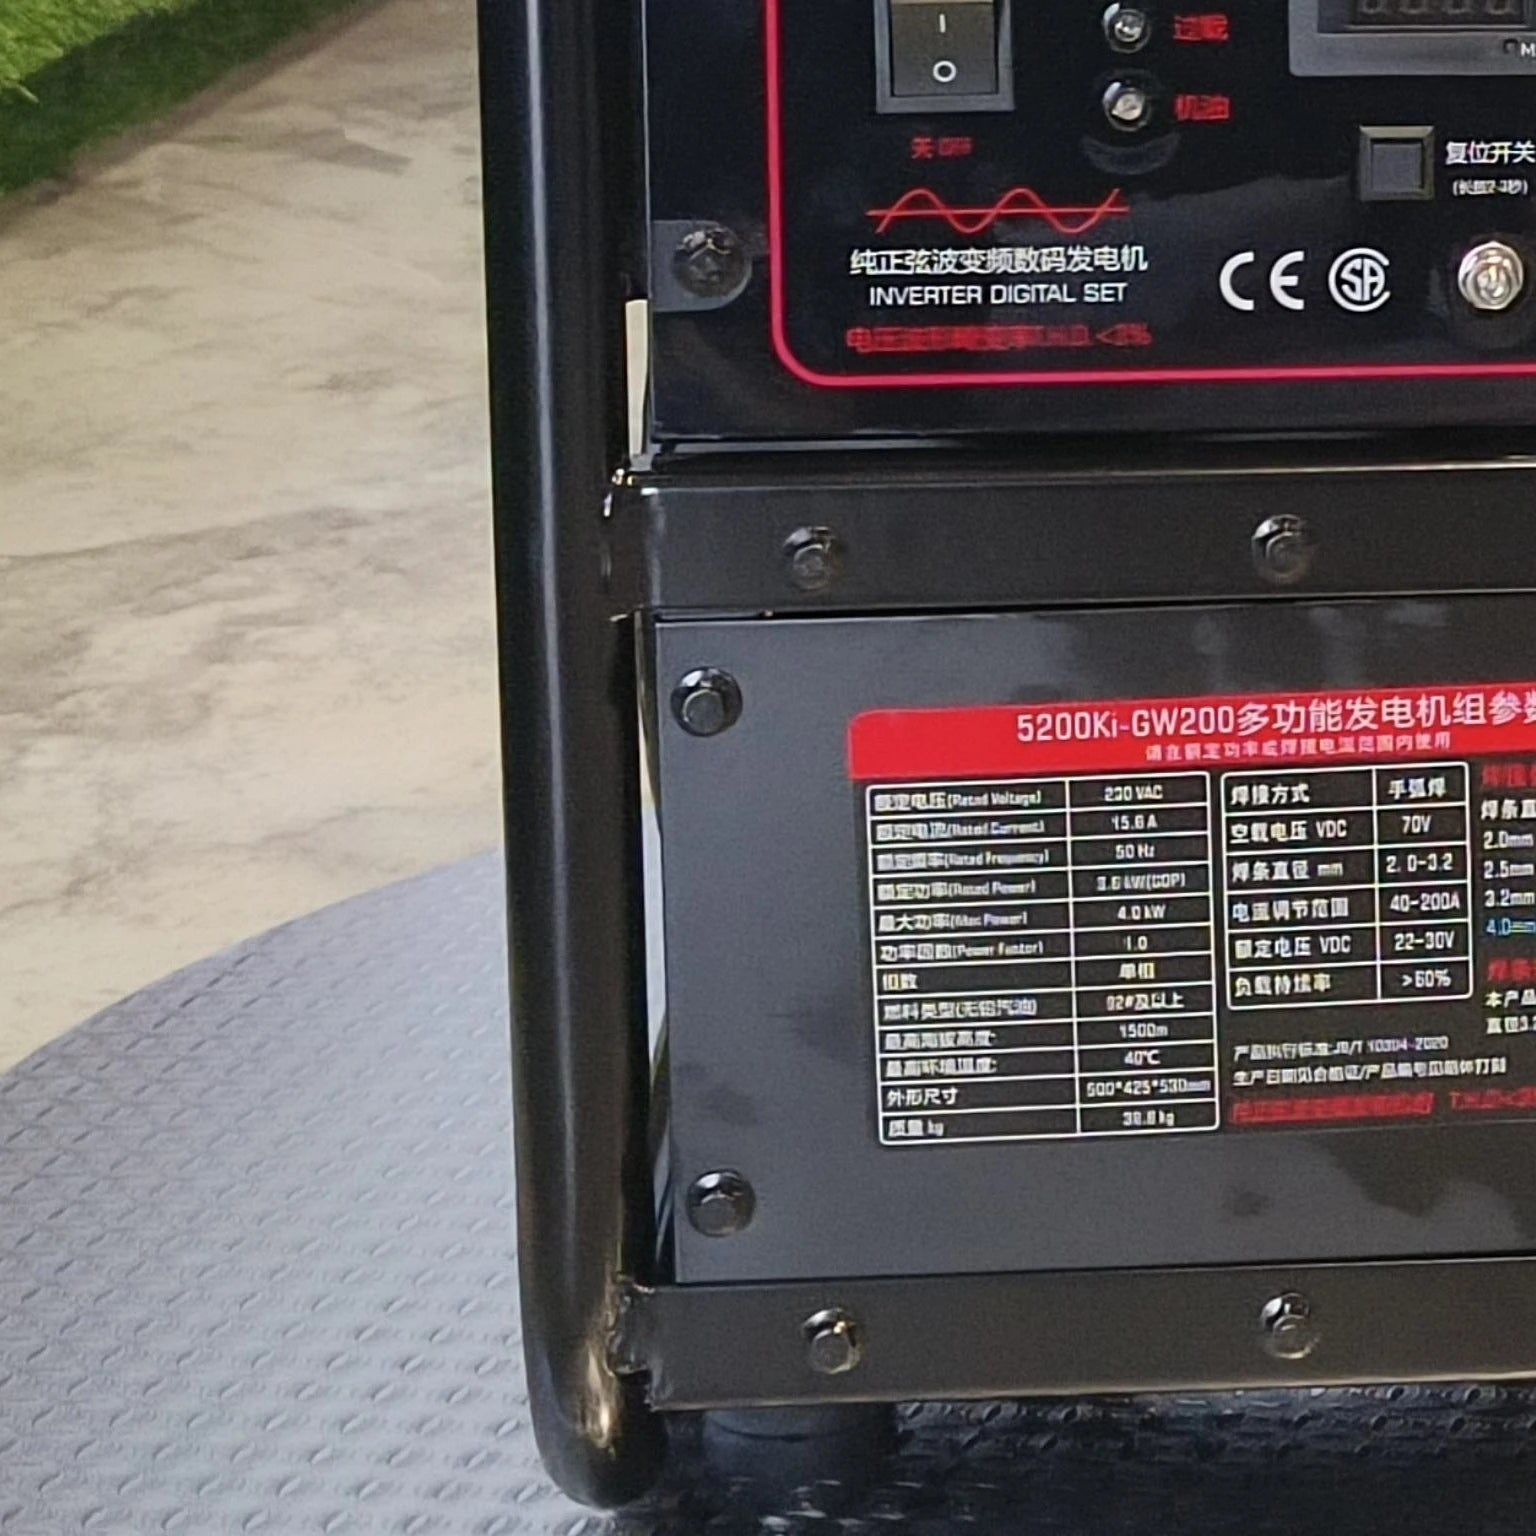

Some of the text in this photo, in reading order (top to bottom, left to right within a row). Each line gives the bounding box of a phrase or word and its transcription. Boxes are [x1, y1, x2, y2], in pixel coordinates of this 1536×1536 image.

[1445, 140, 1536, 165] 复位开关
[849, 245, 1149, 276] 纯正弦波变频数码发电机
[1219, 250, 1304, 312] CE
[870, 282, 1128, 306] INVERTER DIGITAL SET
[1231, 783, 1310, 806] 焊接方式
[1316, 819, 1347, 838] VDC
[1402, 815, 1432, 834] 70V
[1389, 892, 1460, 913] 40-200A
[1320, 935, 1351, 954] VDC
[1394, 931, 1455, 951] 22-30V
[887, 1087, 959, 1107] 外形尺寸
